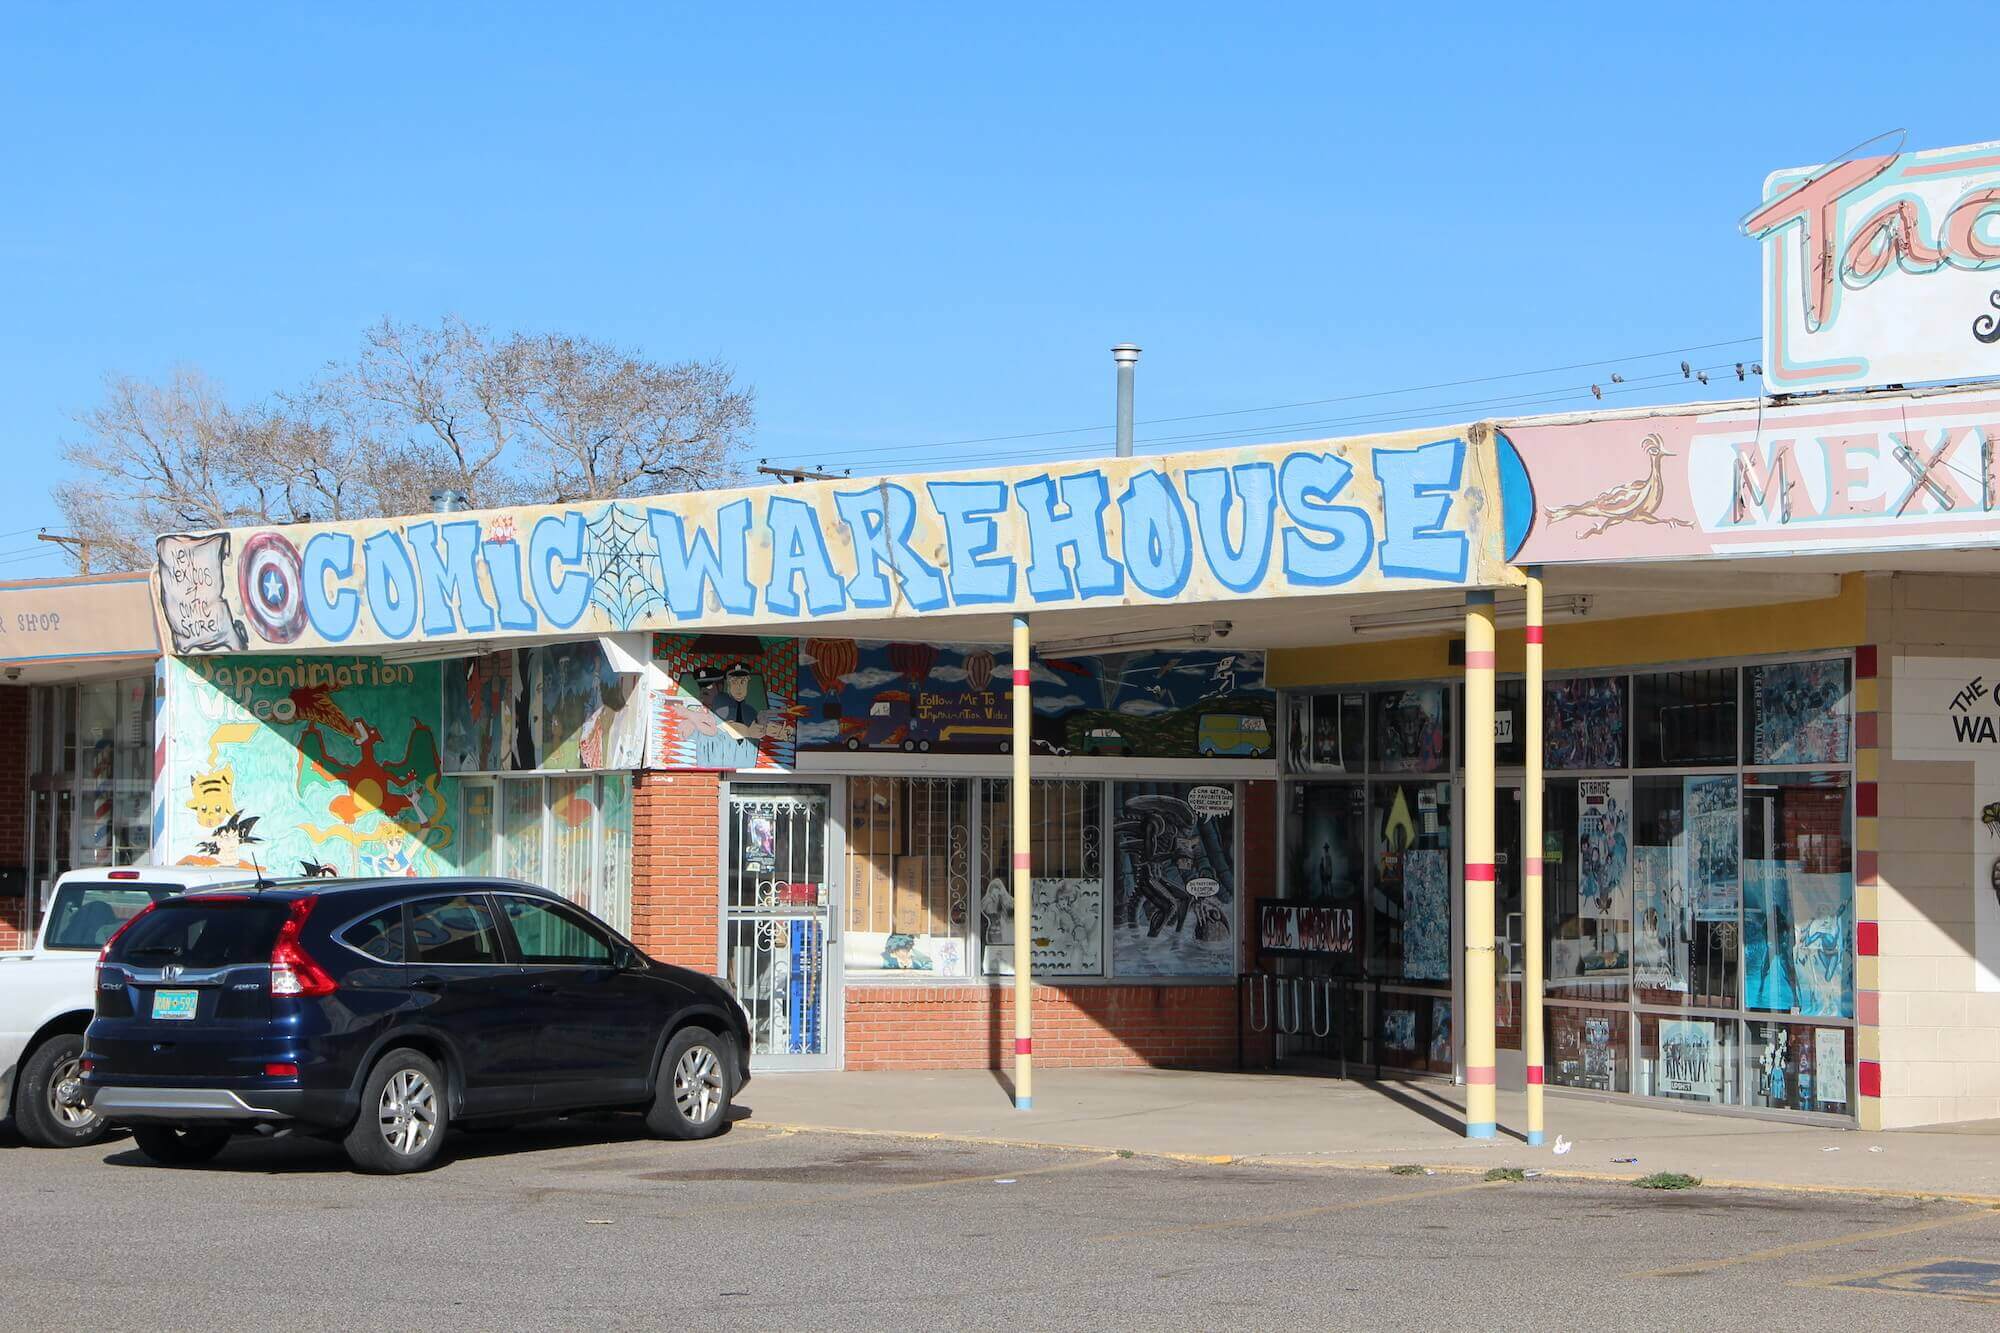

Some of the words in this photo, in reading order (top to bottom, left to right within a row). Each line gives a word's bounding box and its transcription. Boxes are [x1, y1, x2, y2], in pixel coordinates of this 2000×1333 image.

[648, 438, 1468, 621] WAREHOUSE
[17, 612, 60, 632] SHOP
[184, 655, 414, 699] Japanimation
[196, 685, 297, 722] Video
[920, 692, 953, 706] Follow
[981, 692, 995, 705] To
[1948, 676, 1988, 713] THE
[1952, 715, 2000, 744] WA
[1580, 781, 1610, 798] STRANGE
